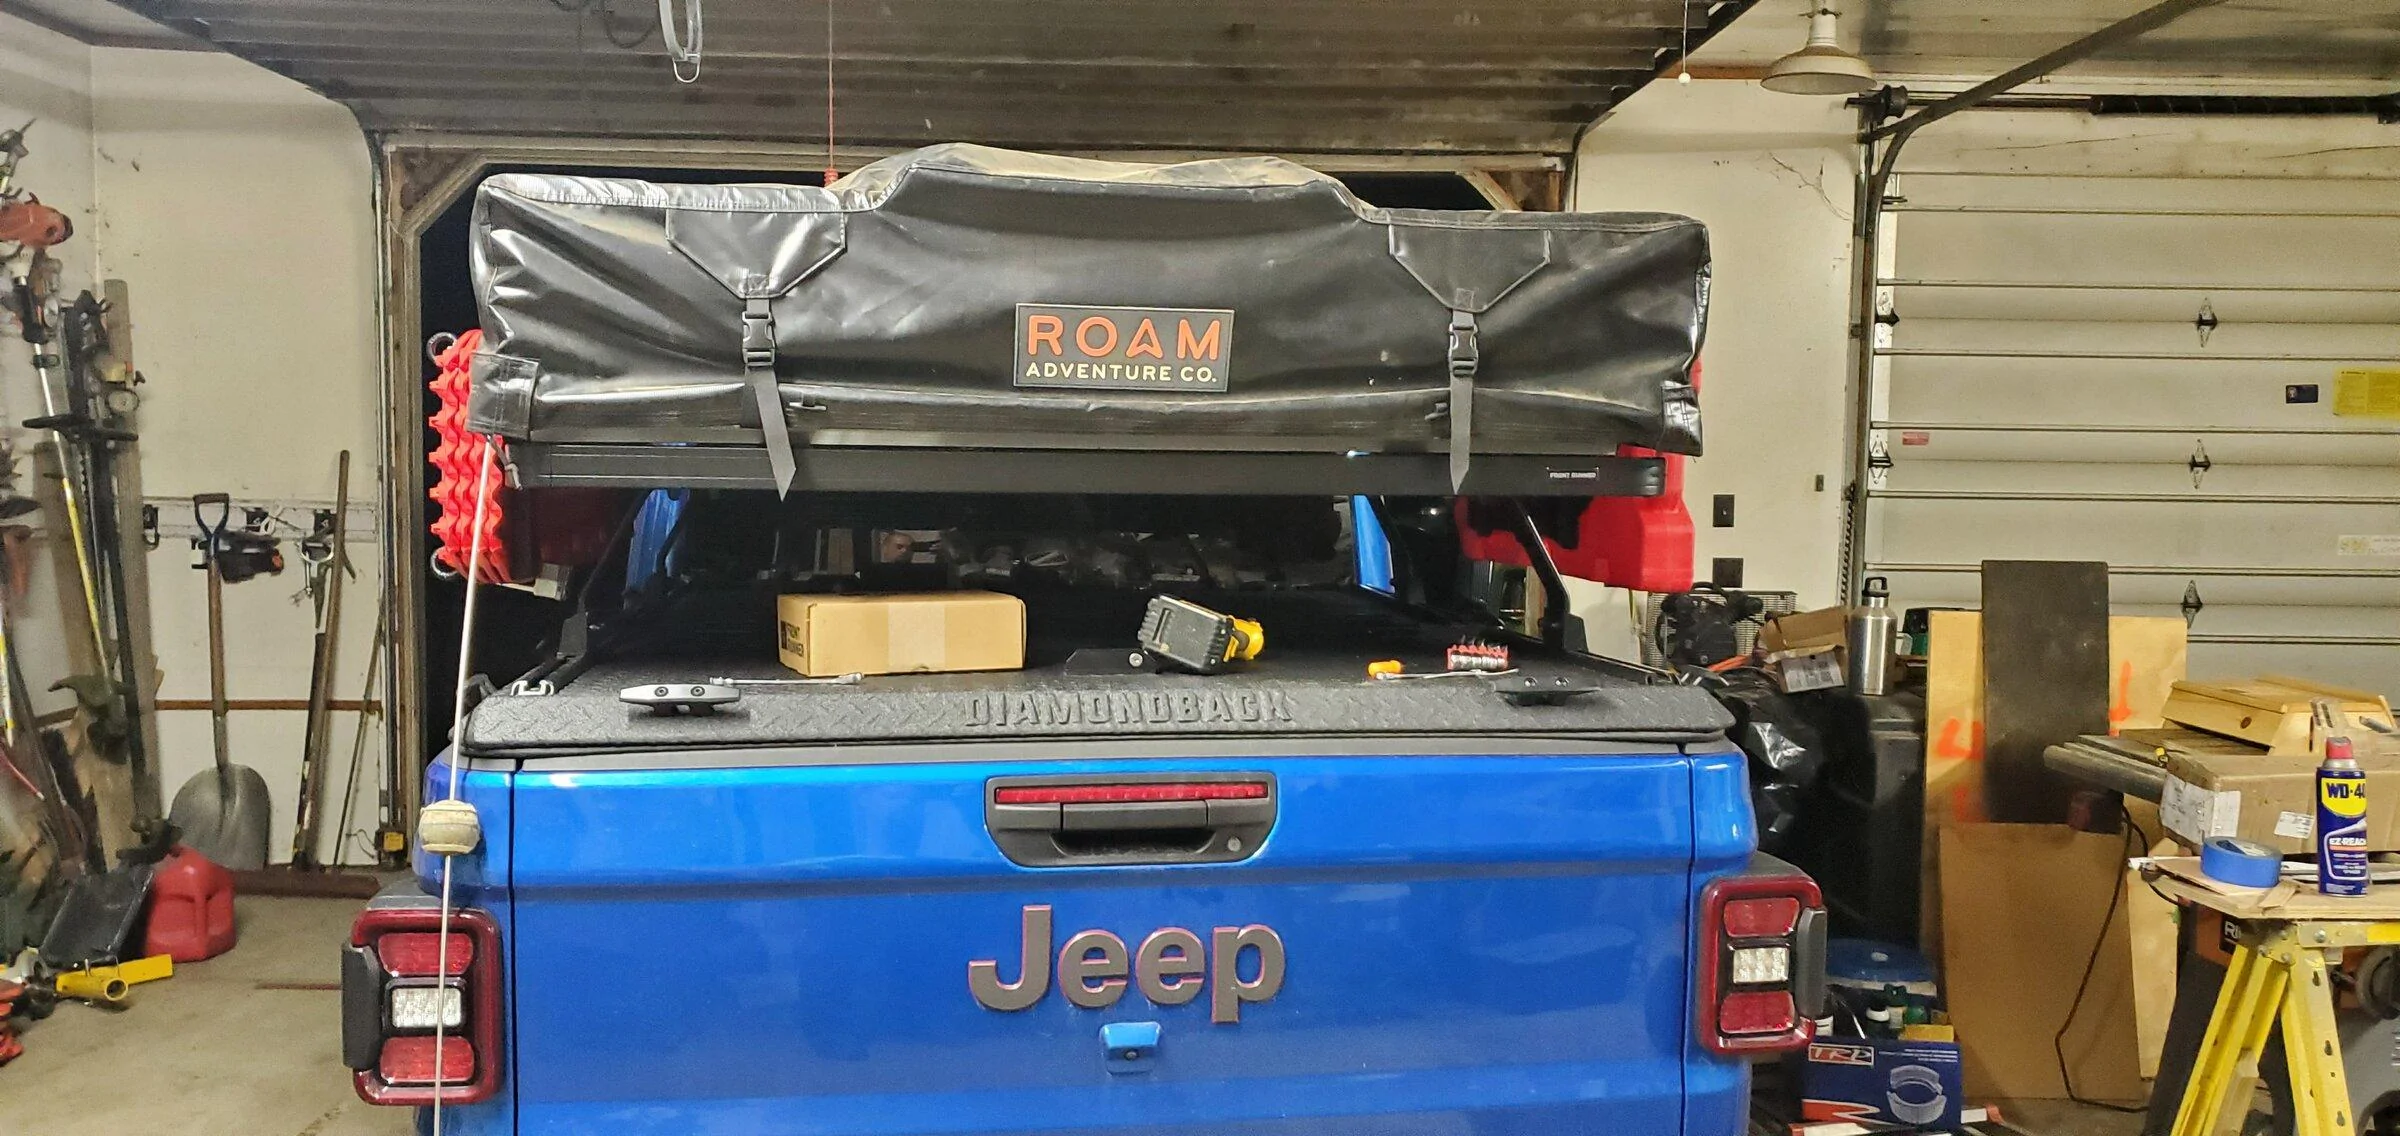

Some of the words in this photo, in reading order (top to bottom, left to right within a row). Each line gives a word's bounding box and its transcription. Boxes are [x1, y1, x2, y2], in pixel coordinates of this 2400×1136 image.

[1027, 314, 1221, 361] ROAM
[1025, 361, 1172, 382] ADVENTURE
[1179, 366, 1218, 383] CO.
[963, 690, 1294, 727] DIAMONDBACK
[968, 904, 1286, 1023] Jeep
